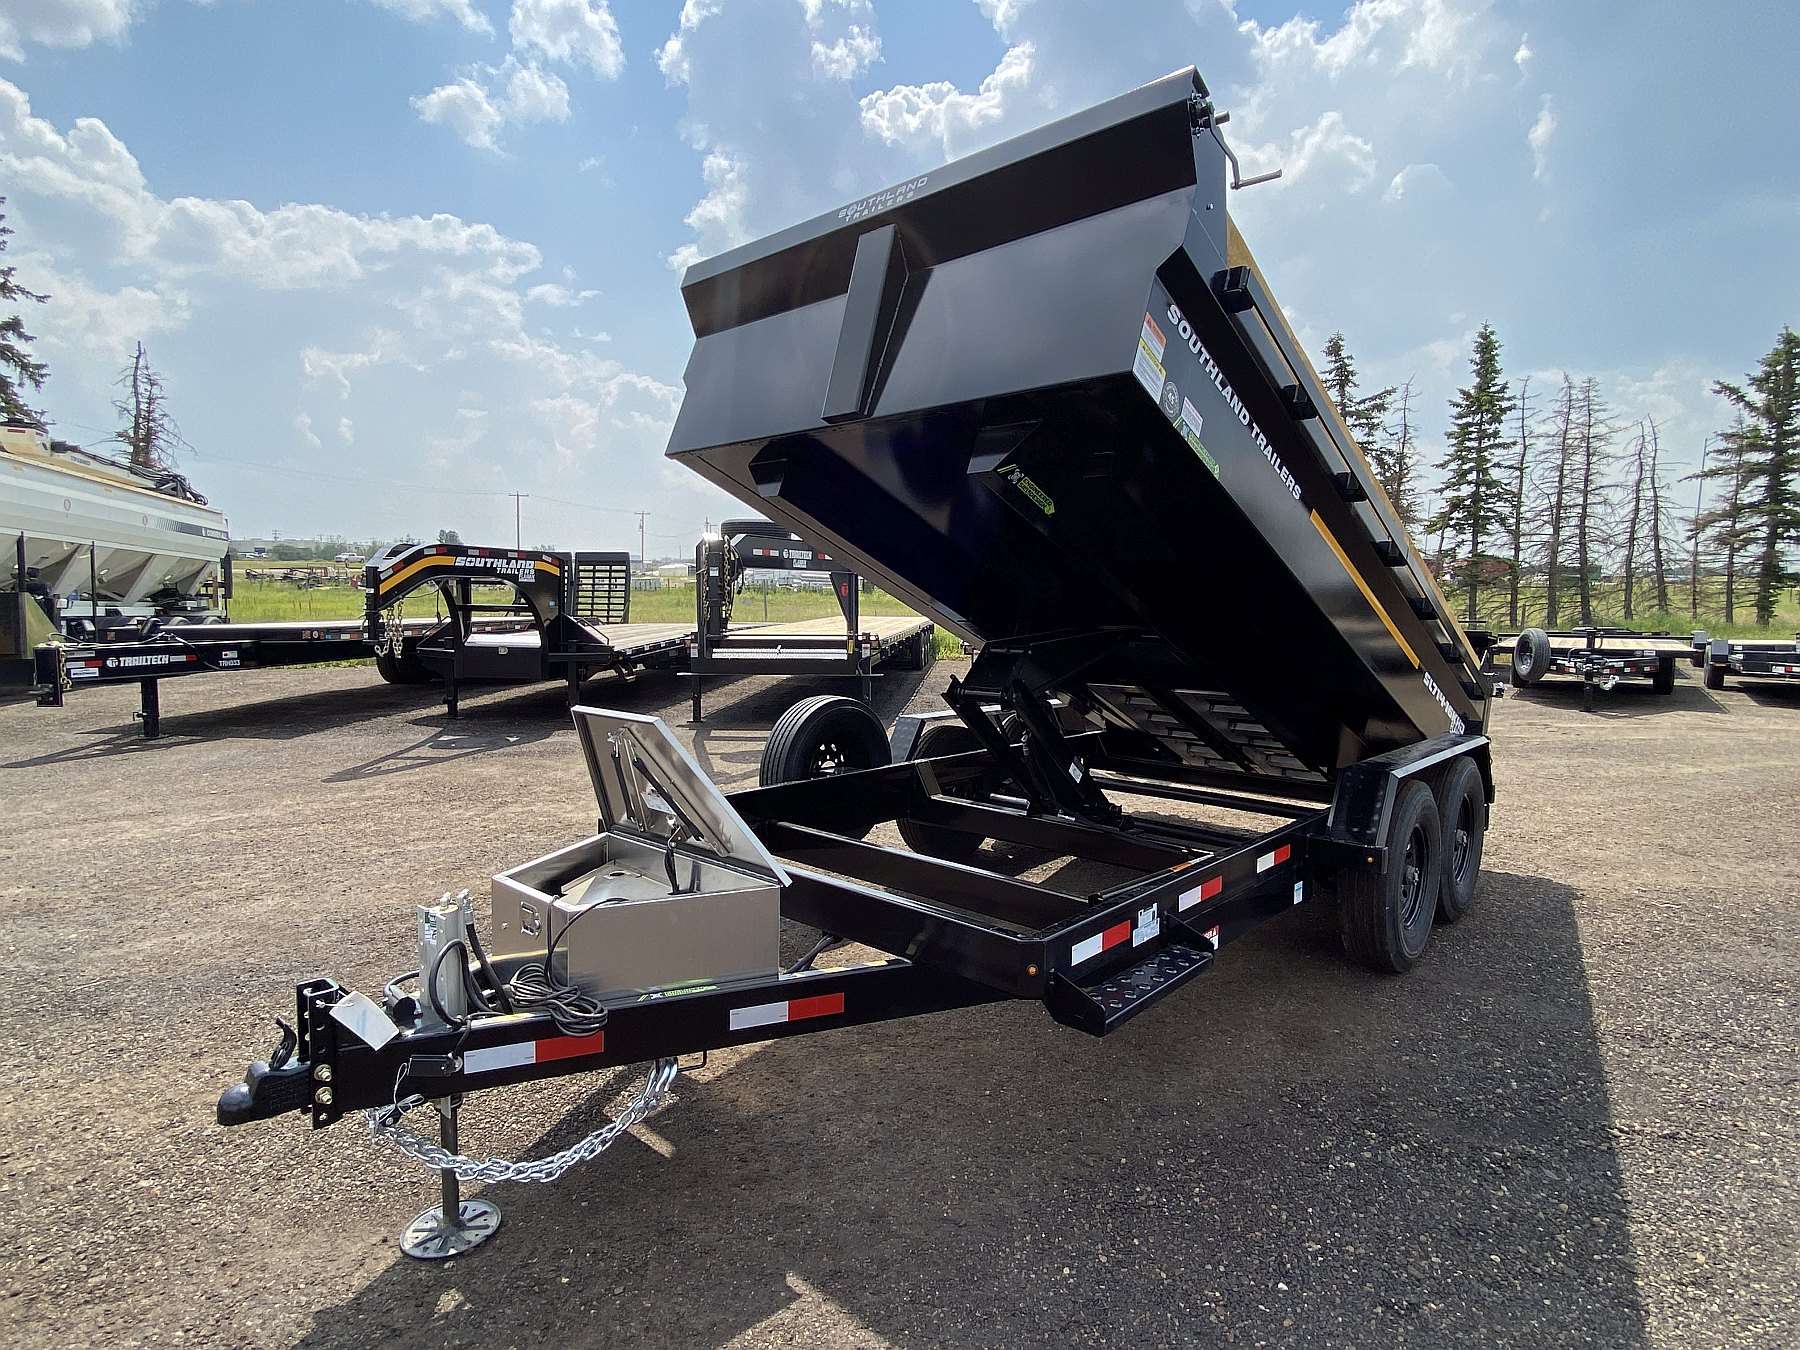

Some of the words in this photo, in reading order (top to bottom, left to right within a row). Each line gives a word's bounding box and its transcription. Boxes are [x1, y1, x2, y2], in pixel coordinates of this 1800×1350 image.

[838, 177, 928, 218] SOUTHLAND
[845, 191, 914, 222] TRAILERS
[1167, 304, 1250, 426] SOUTHLAND
[1250, 423, 1301, 500] TRAILERS
[455, 556, 535, 569] SOUTHLAND
[496, 567, 535, 575] TRAILERS
[119, 655, 169, 667] TRAILTECH
